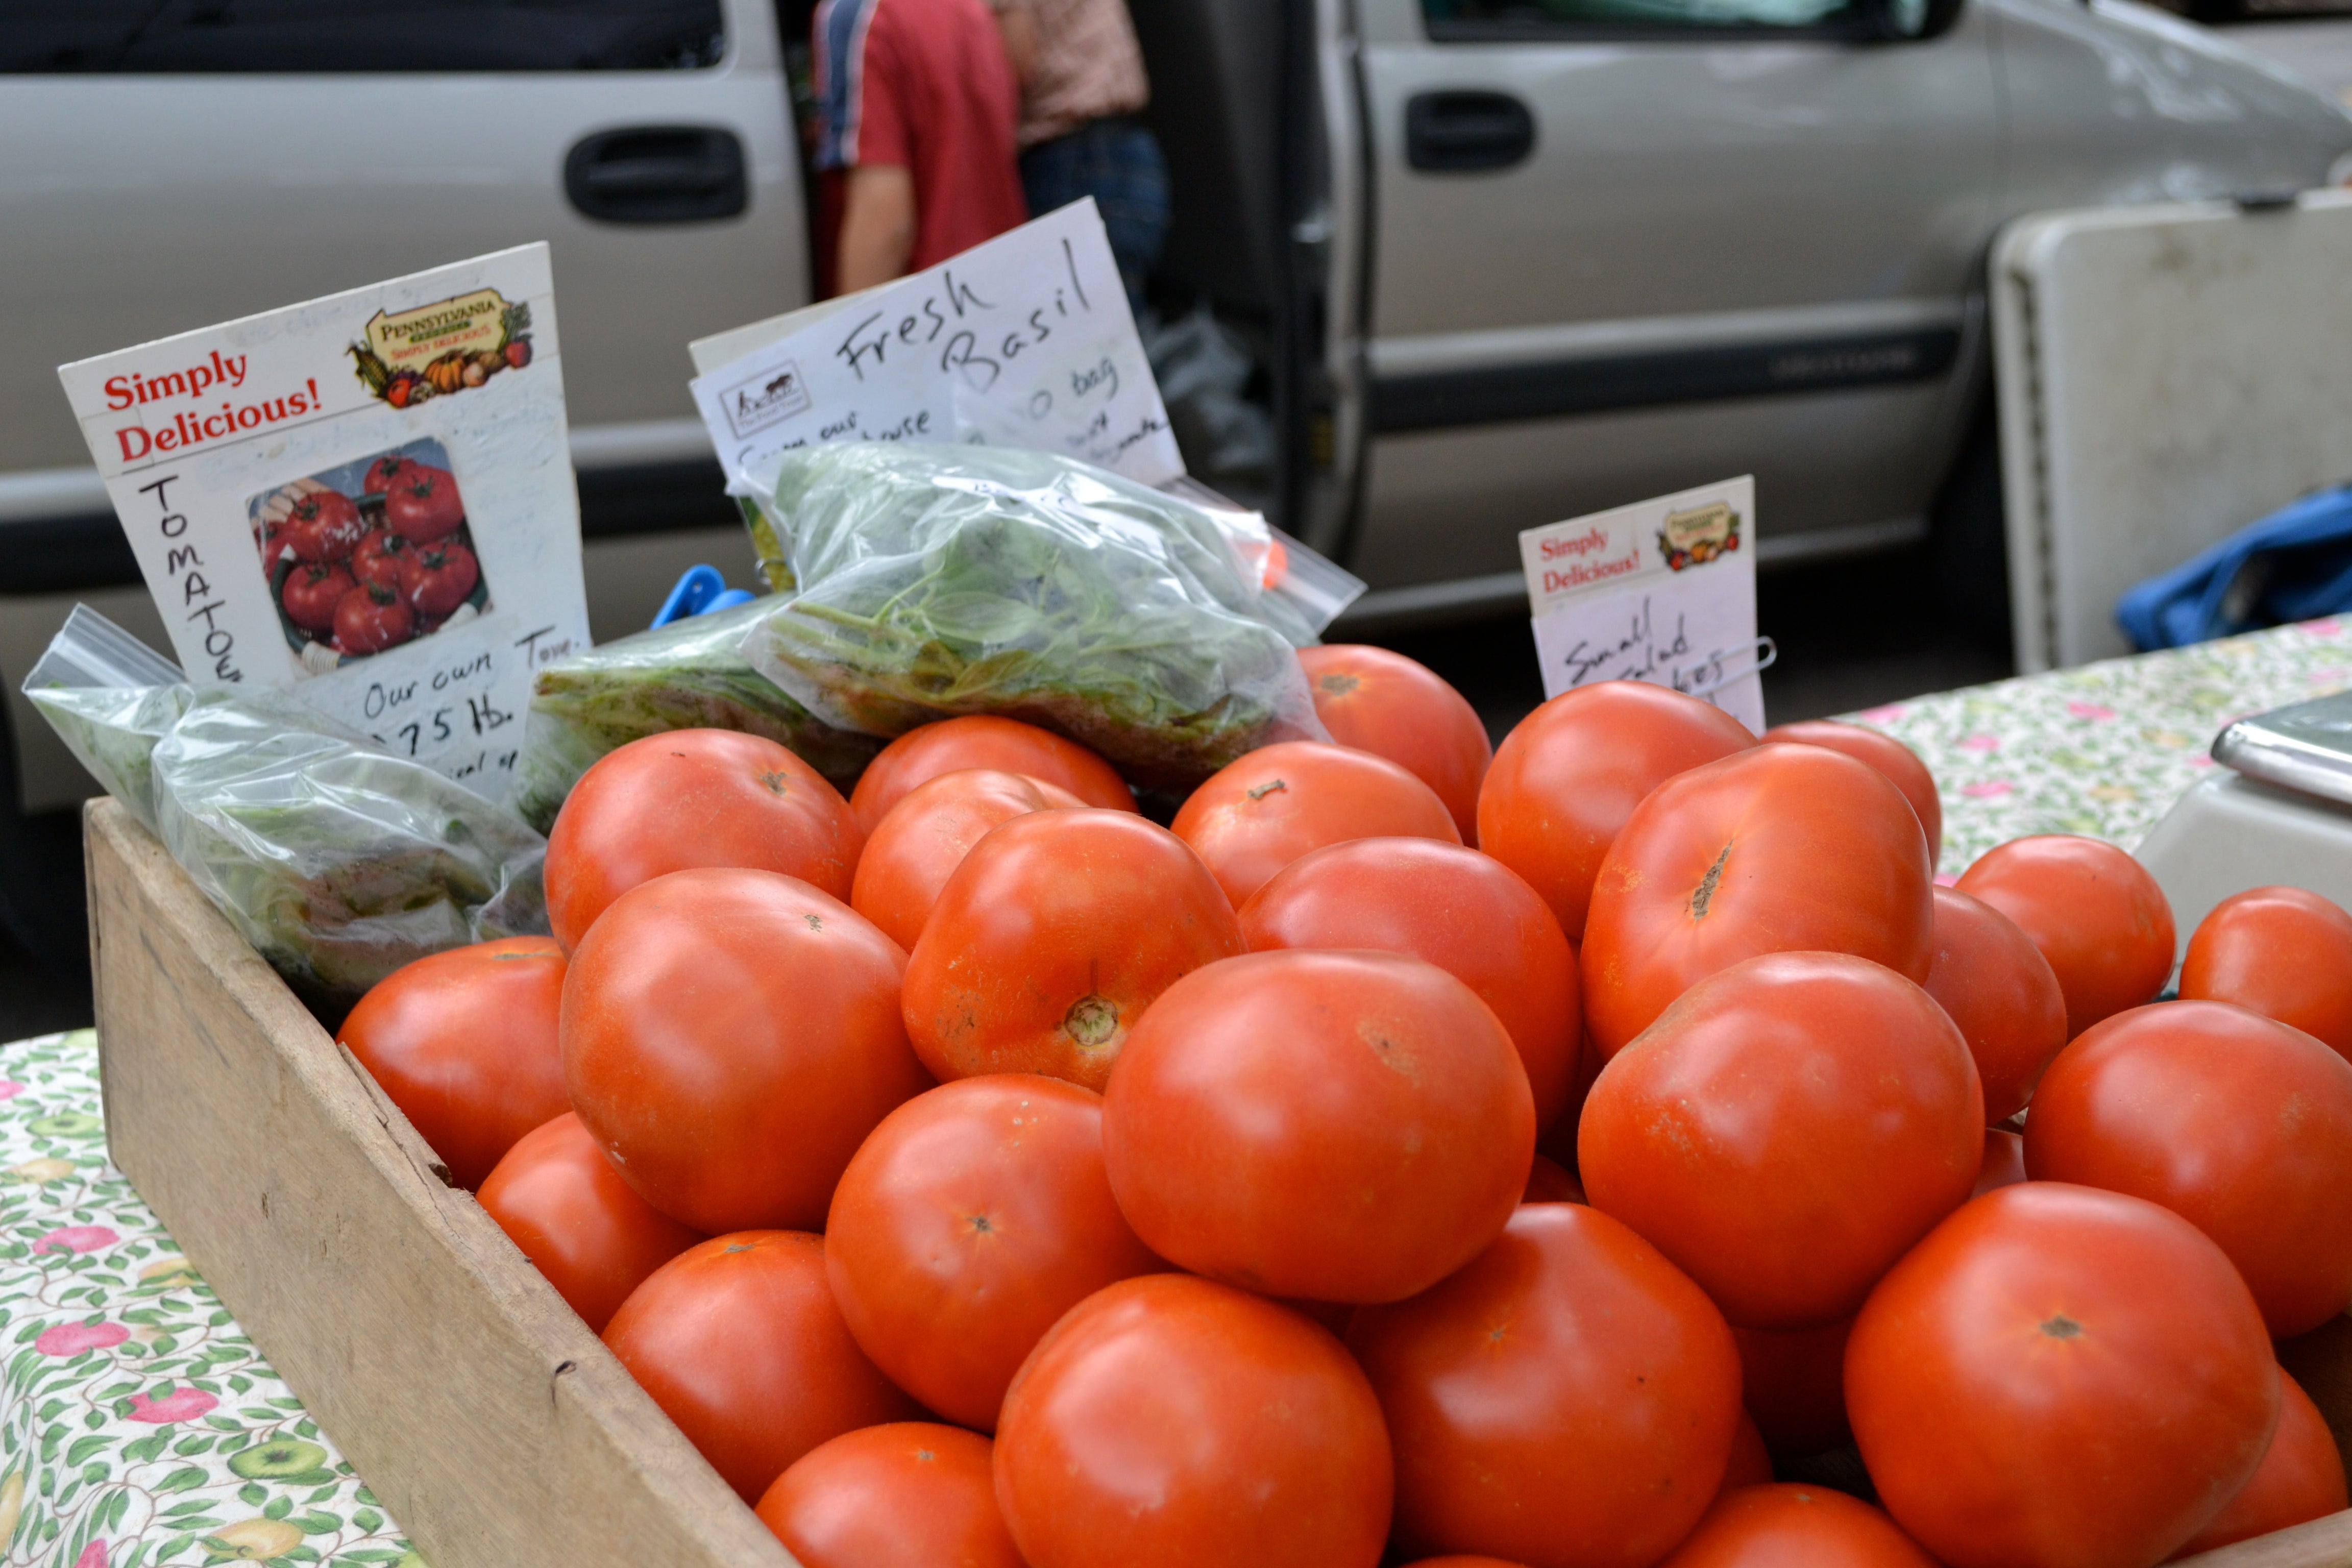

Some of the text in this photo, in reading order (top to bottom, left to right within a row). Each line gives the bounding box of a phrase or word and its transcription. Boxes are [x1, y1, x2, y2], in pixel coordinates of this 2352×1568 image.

[380, 300, 496, 342] PENNSYLVANIA
[390, 342, 431, 361] SIMPLY
[433, 323, 492, 348] DELICIOUS
[837, 271, 998, 382] Fresh
[941, 237, 1091, 394] Basil
[104, 350, 247, 410] Simply
[115, 378, 322, 462] Delicious!
[1540, 526, 1609, 562] Simply
[1544, 549, 1639, 595] Delicious!
[365, 681, 419, 719] Our
[432, 652, 492, 692] own
